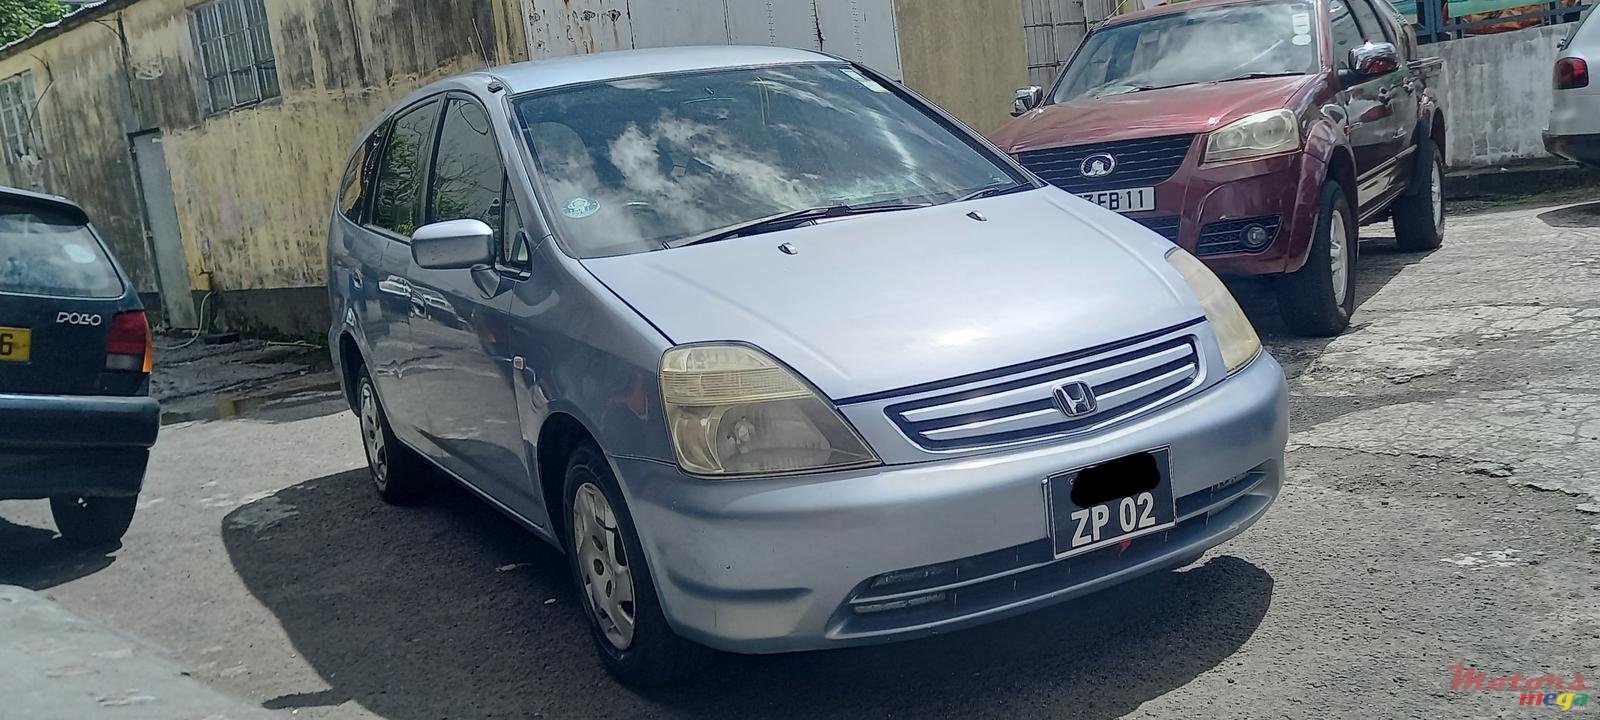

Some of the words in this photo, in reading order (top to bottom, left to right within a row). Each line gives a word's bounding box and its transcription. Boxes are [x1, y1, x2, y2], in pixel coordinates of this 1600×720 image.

[56, 312, 102, 326] POLO
[0, 333, 13, 355] 6
[1071, 504, 1110, 548] ZP
[1119, 491, 1156, 533] 02
